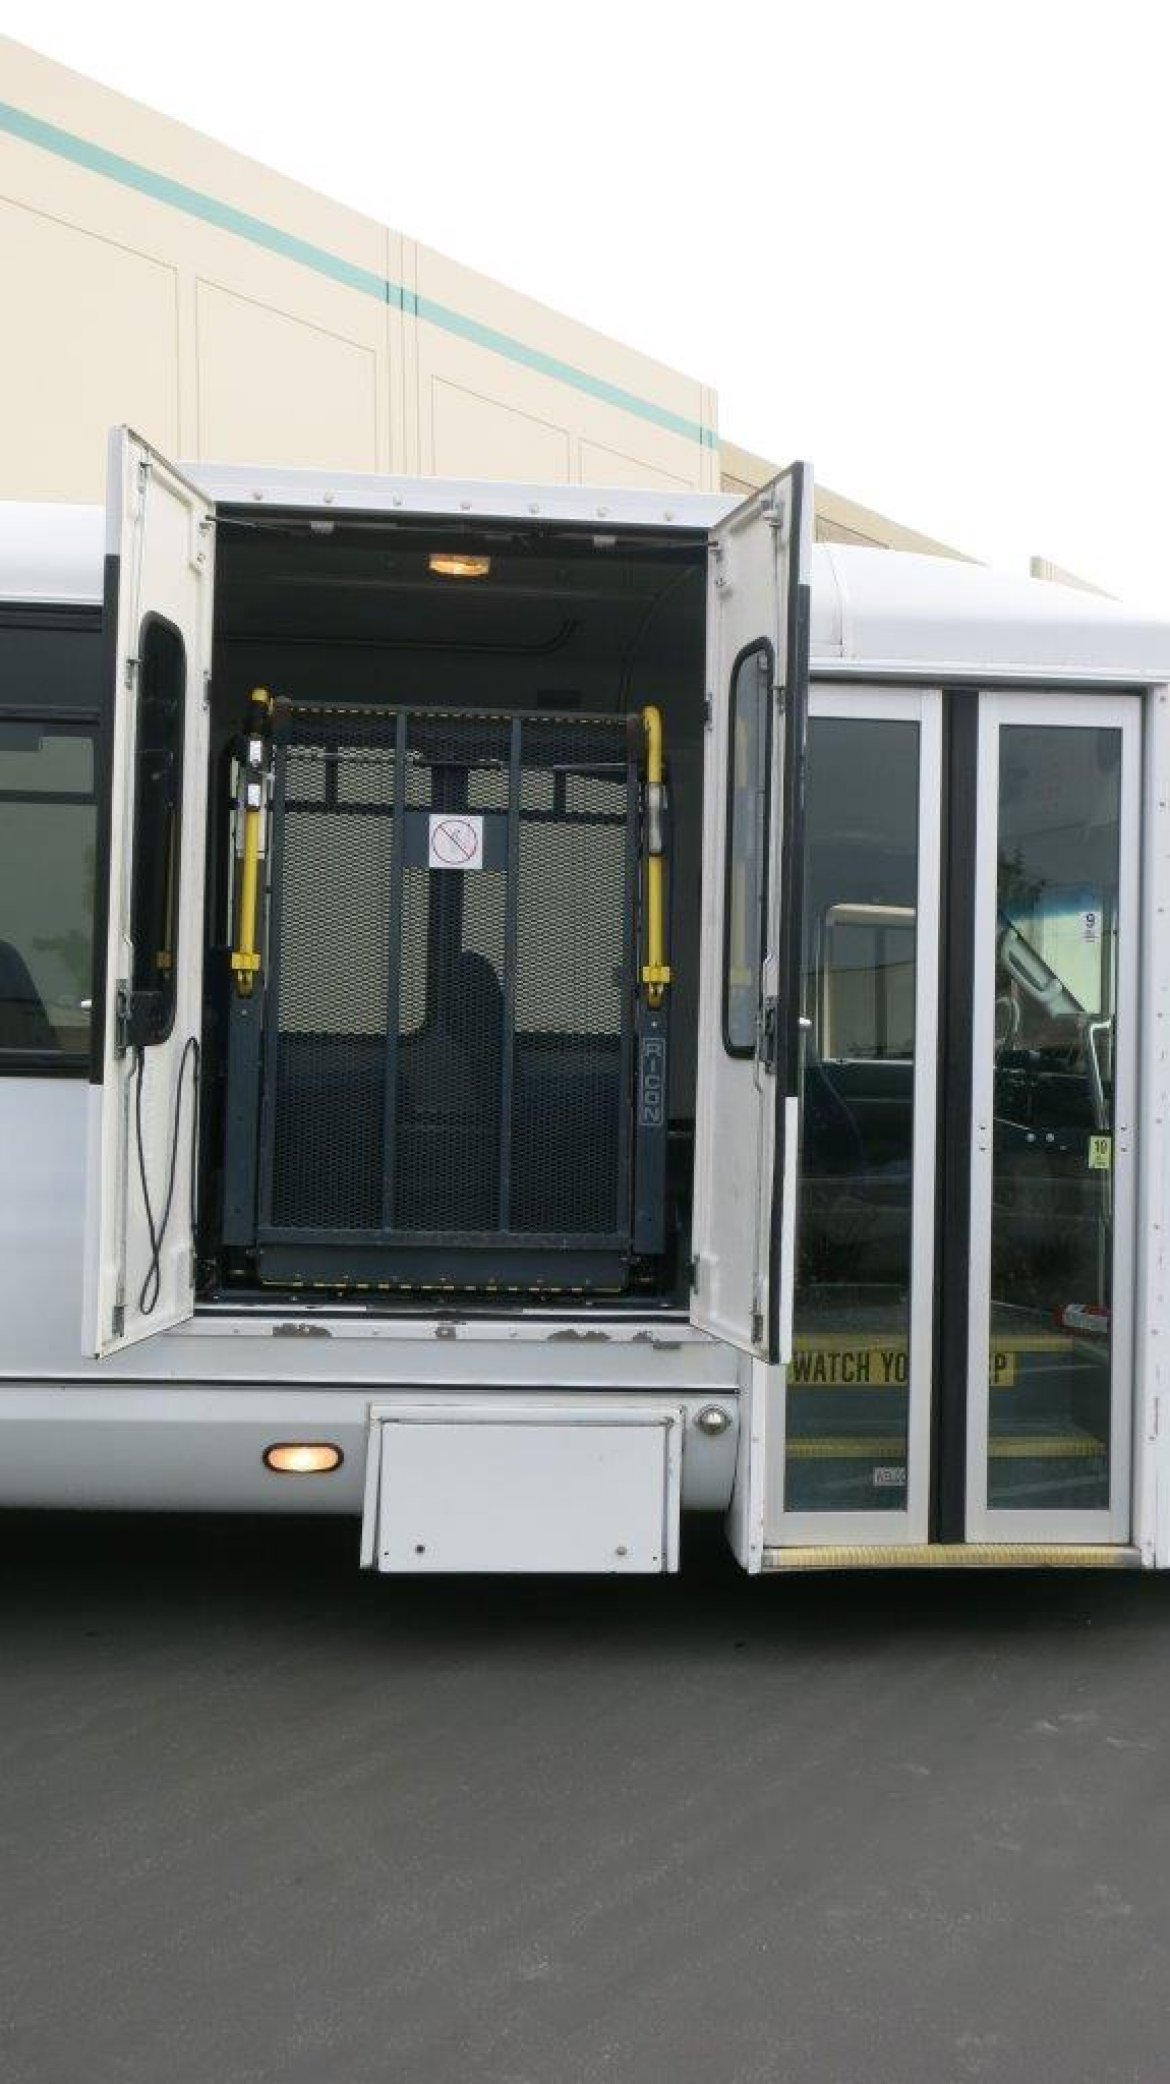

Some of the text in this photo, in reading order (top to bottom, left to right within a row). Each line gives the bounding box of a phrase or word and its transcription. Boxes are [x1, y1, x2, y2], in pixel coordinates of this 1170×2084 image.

[644, 1043, 662, 1122] RICON
[793, 1351, 907, 1383] WATCH YO
